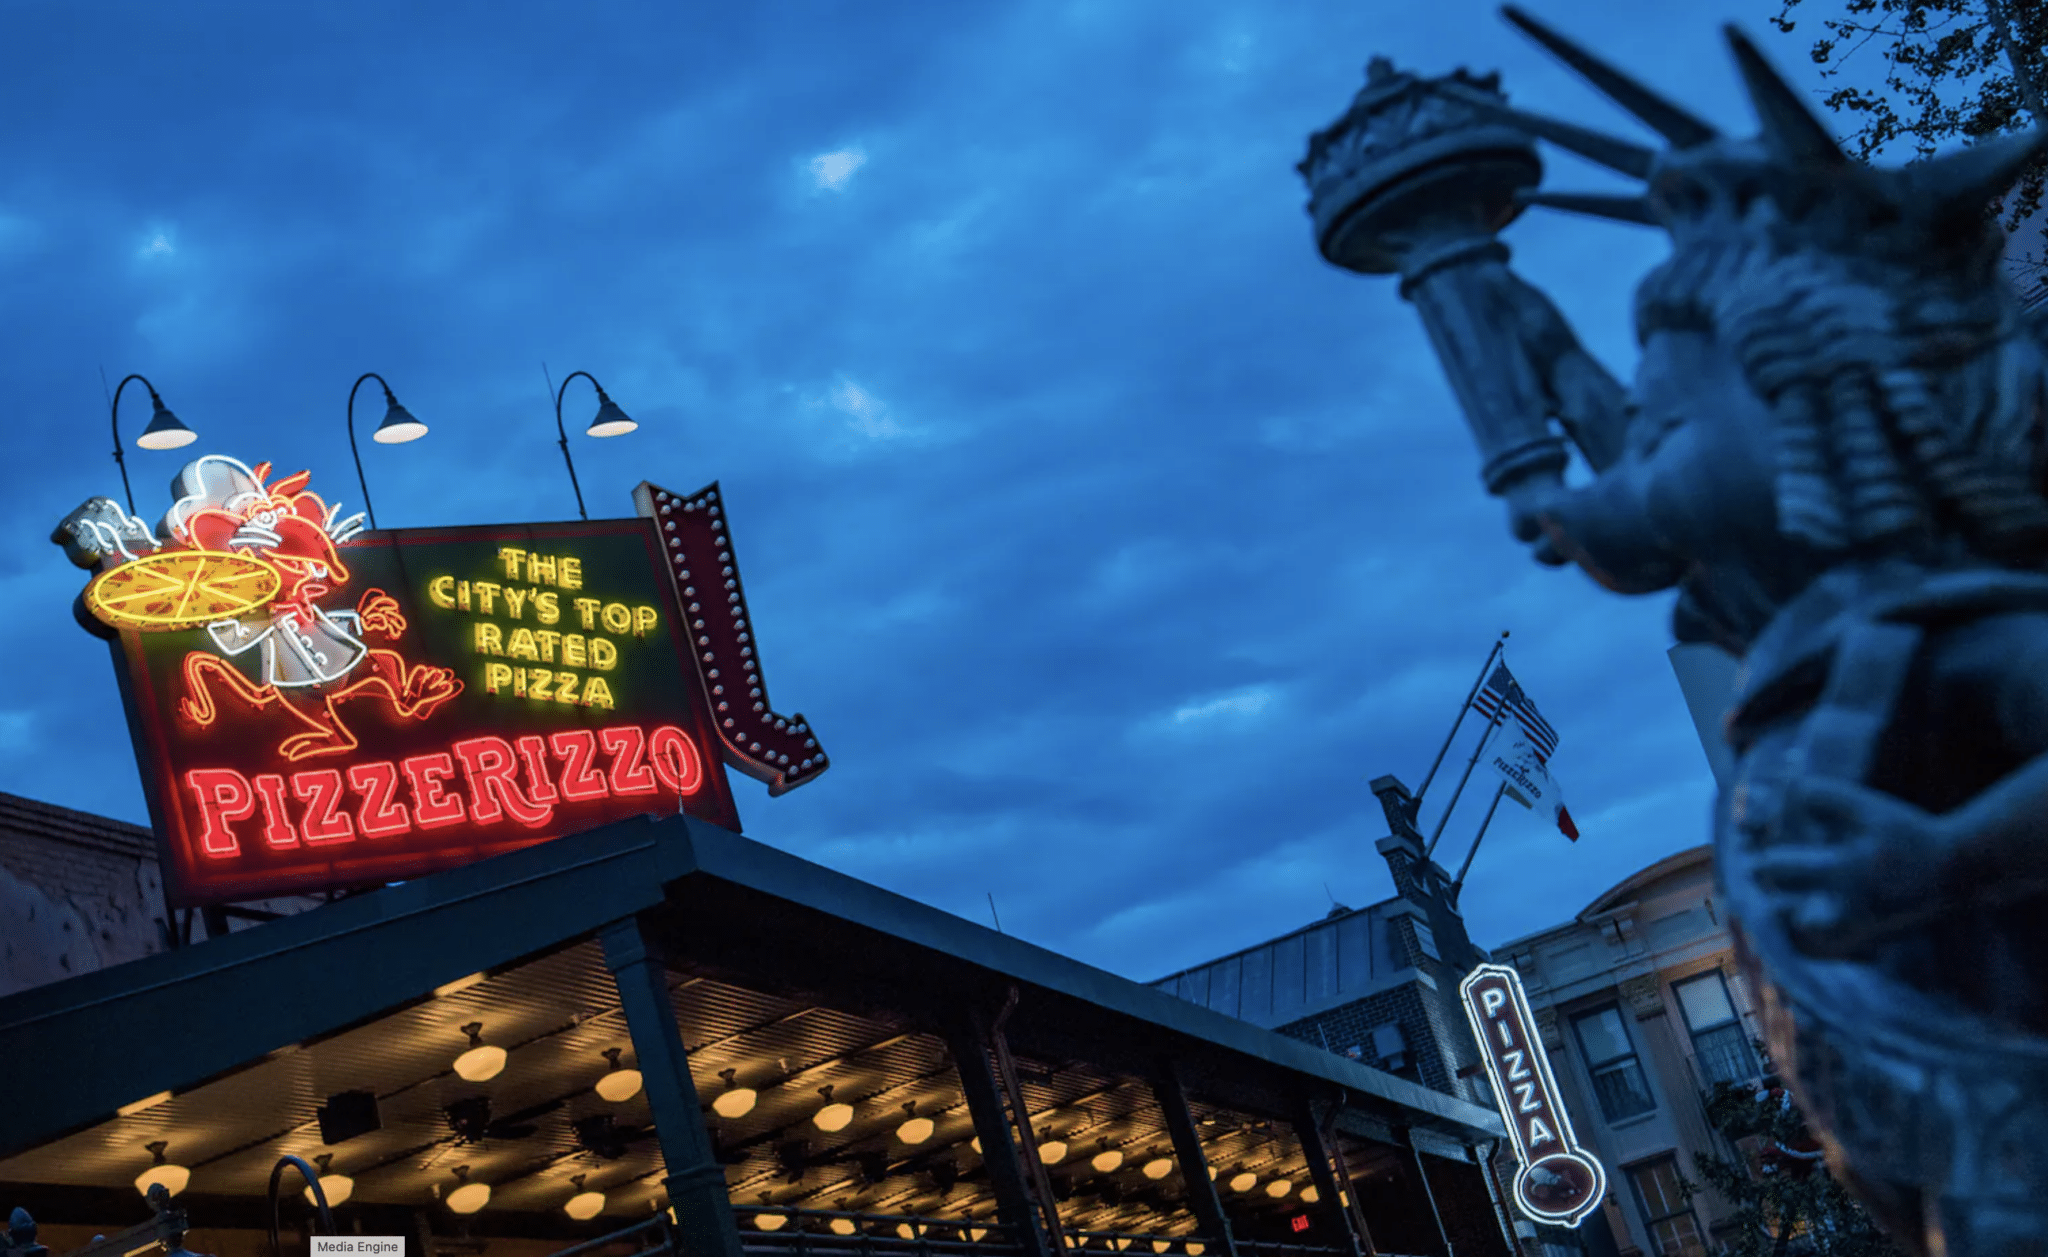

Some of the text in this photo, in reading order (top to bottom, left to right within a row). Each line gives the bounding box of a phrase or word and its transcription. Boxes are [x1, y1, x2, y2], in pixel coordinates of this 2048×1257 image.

[498, 547, 583, 590] THE
[429, 576, 658, 637] CITY'S TOP
[475, 622, 617, 671] RATED
[485, 662, 615, 710] PIZZA
[186, 726, 702, 858] PIZZERIZZO
[1480, 987, 1555, 1148] PIZZA
